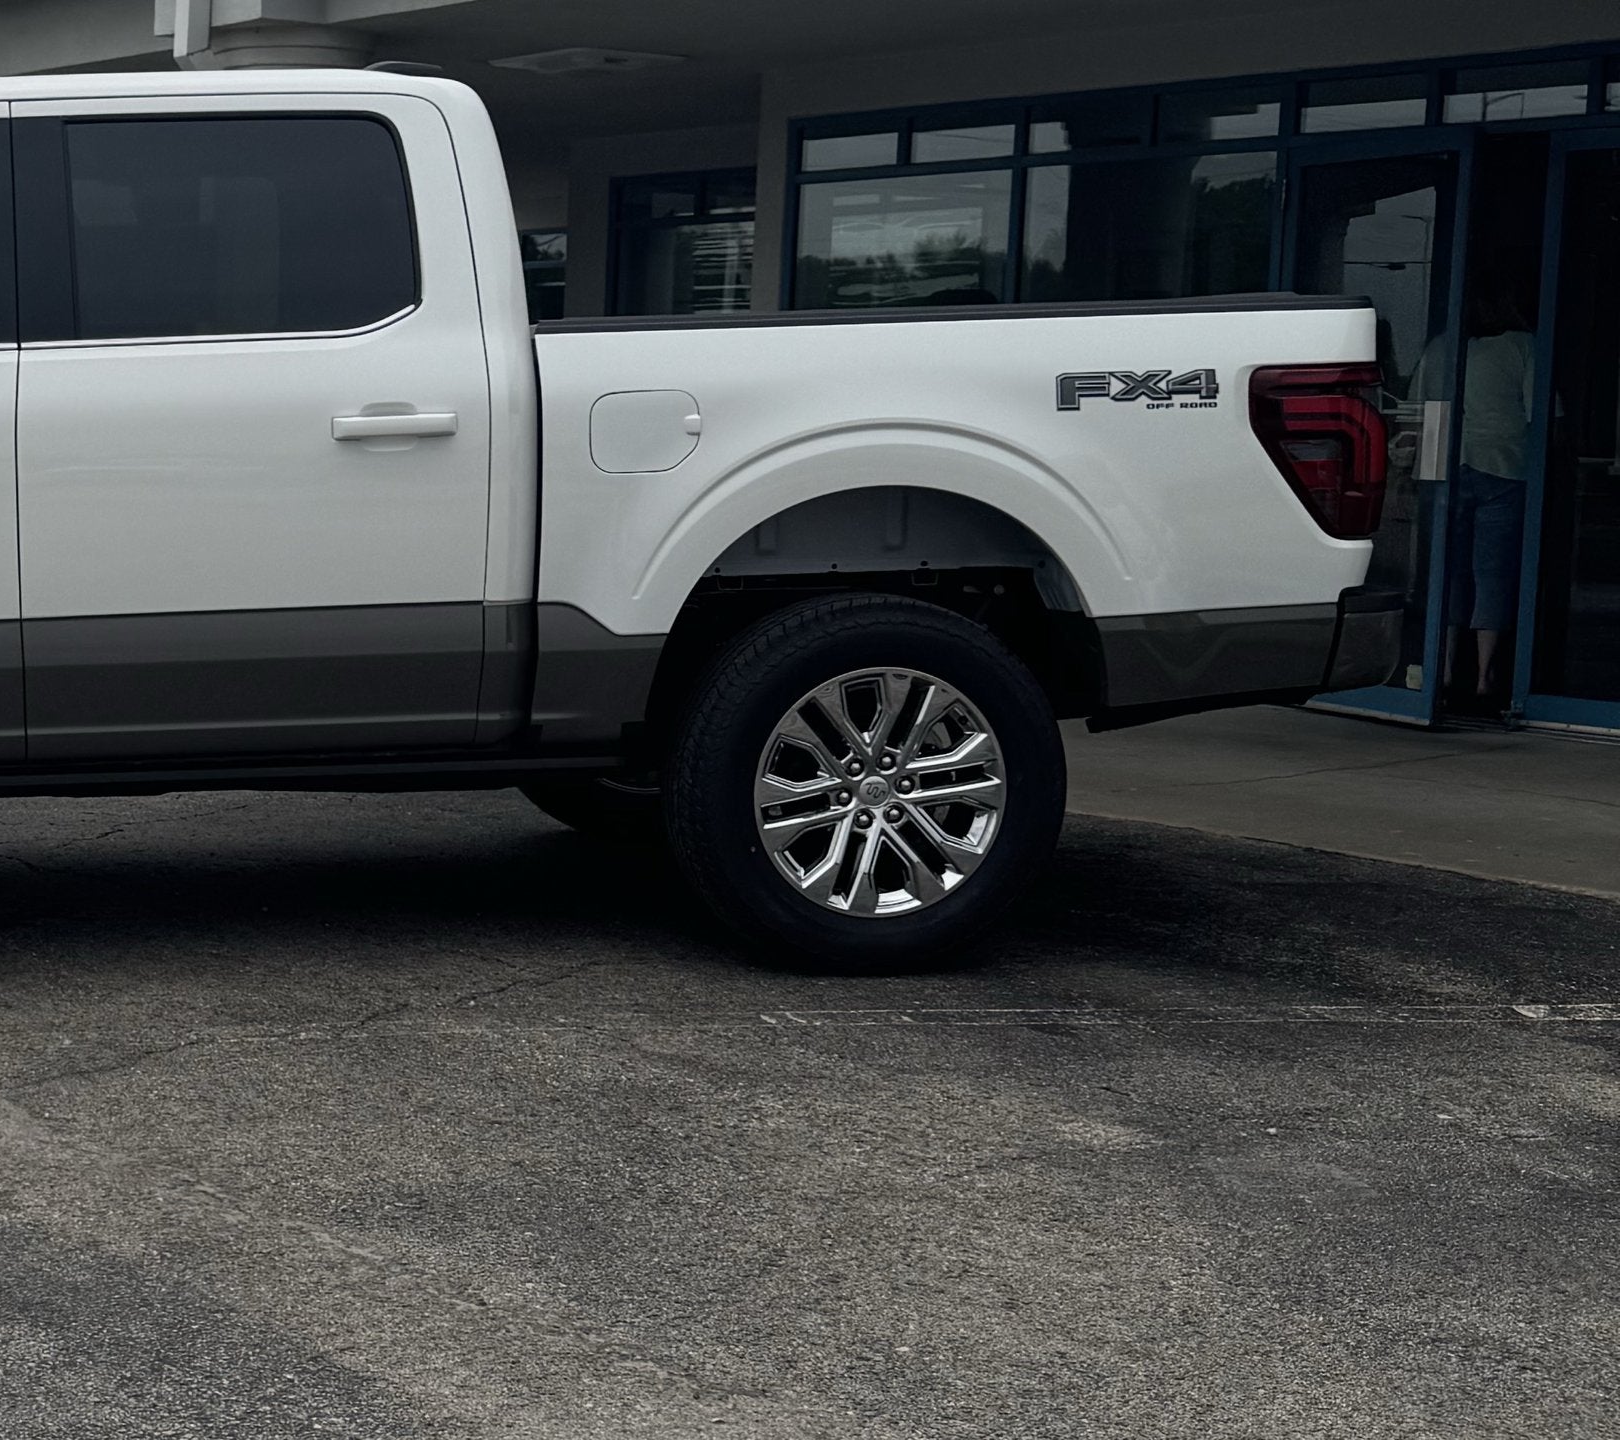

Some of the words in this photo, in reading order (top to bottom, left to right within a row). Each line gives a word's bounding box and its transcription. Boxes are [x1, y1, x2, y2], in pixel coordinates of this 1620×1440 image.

[1056, 369, 1219, 411] FX4
[1146, 402, 1175, 410] OFF
[1180, 401, 1218, 409] ROAD
